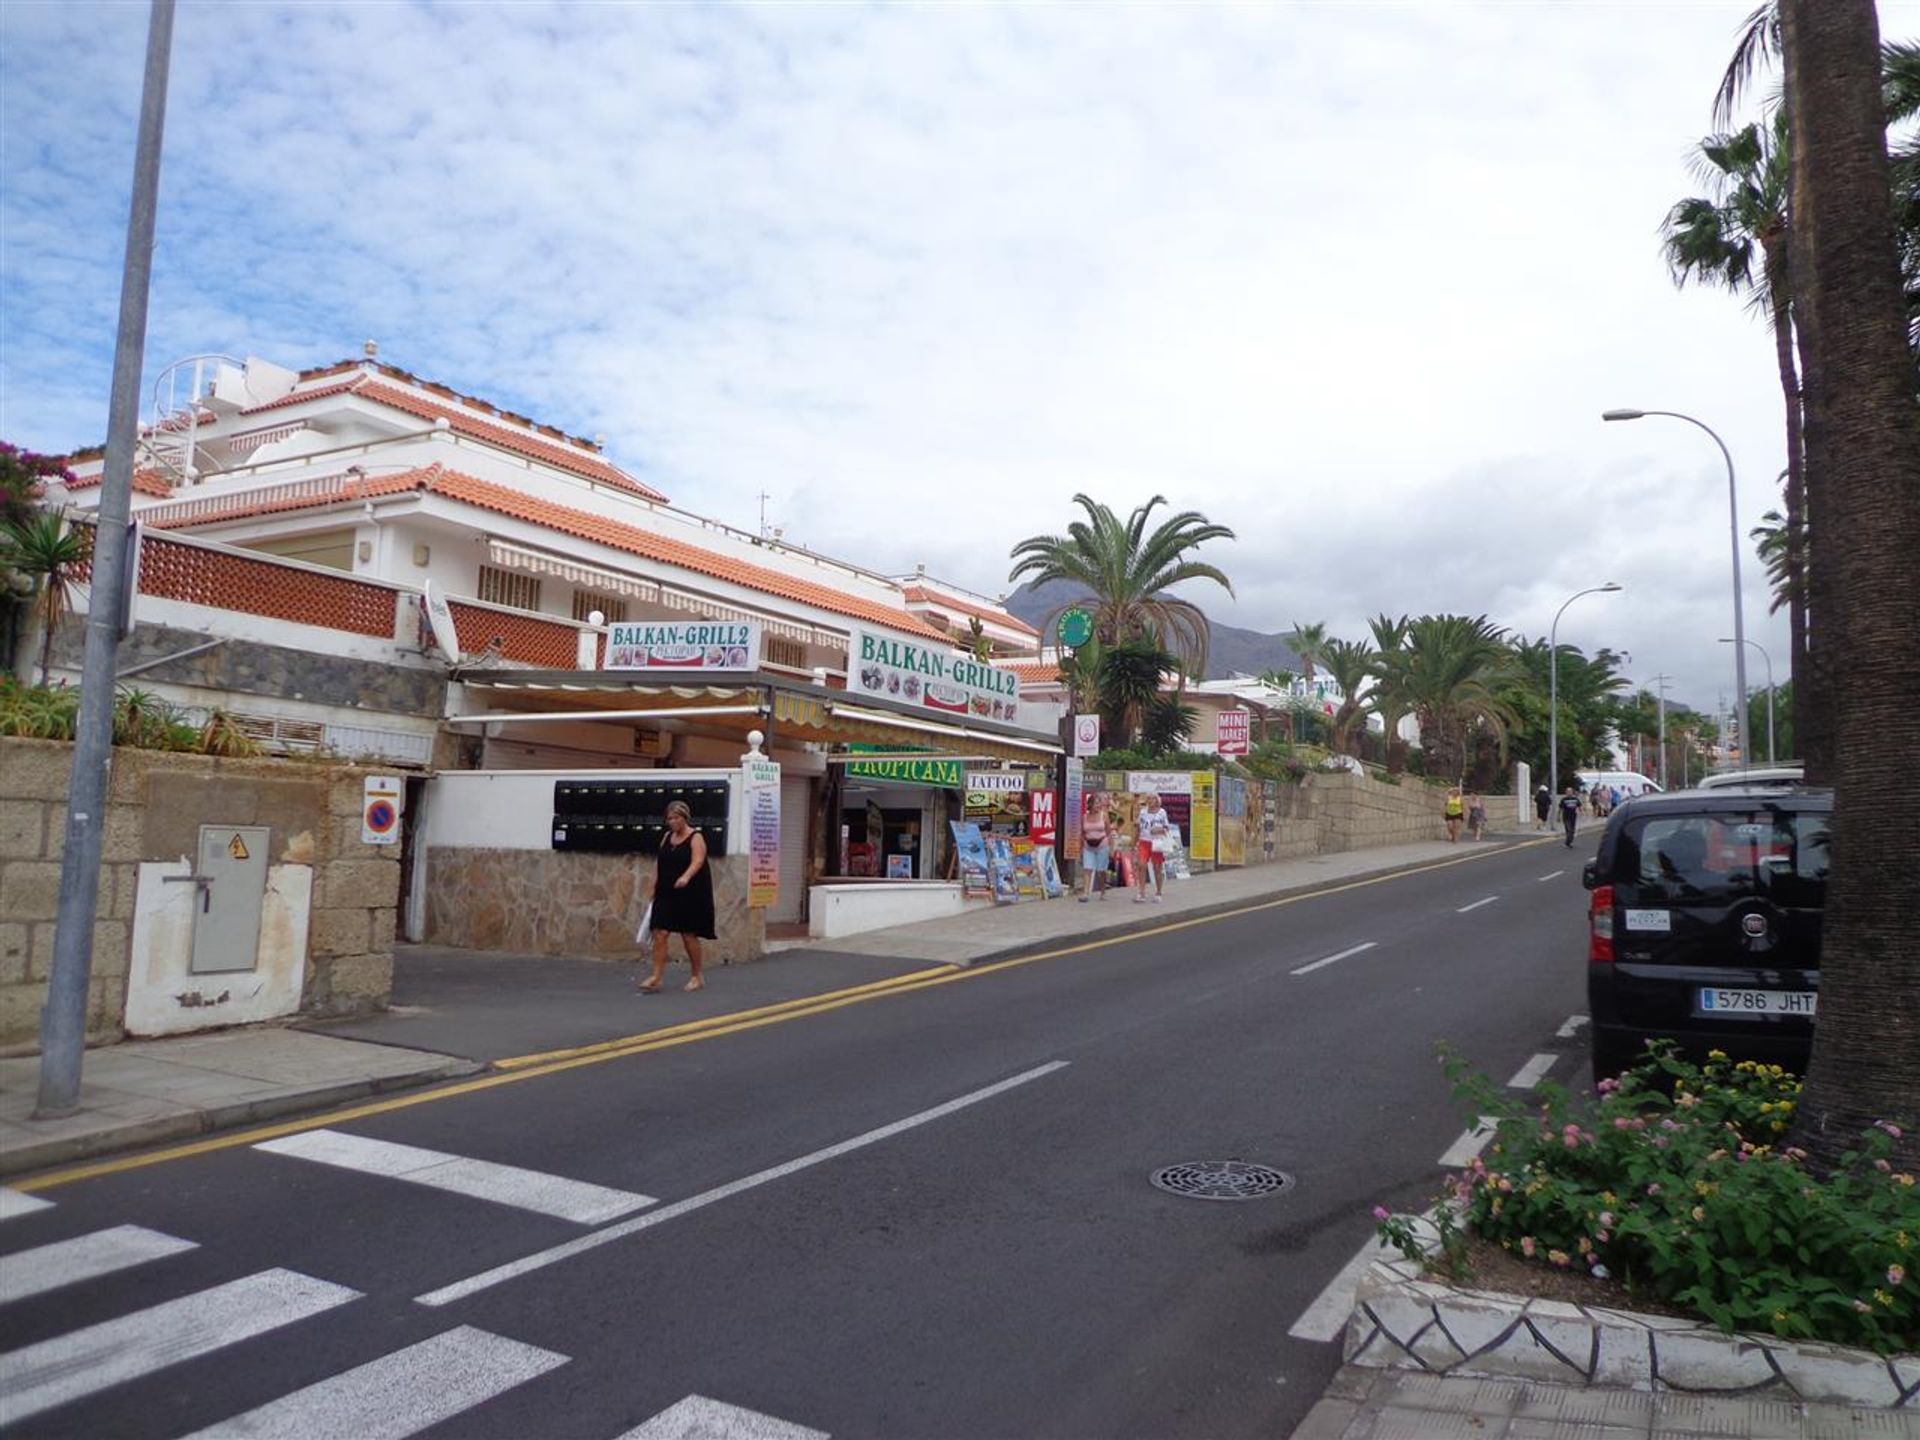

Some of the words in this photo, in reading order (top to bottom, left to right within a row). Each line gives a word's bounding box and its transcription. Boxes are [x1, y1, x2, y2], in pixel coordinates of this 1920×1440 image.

[1220, 713, 1247, 728] MINI
[1220, 728, 1247, 741] MARKET
[970, 775, 1022, 789] TATTOO
[1718, 991, 1767, 1010] 5786
[1778, 994, 1814, 1012] JHT
